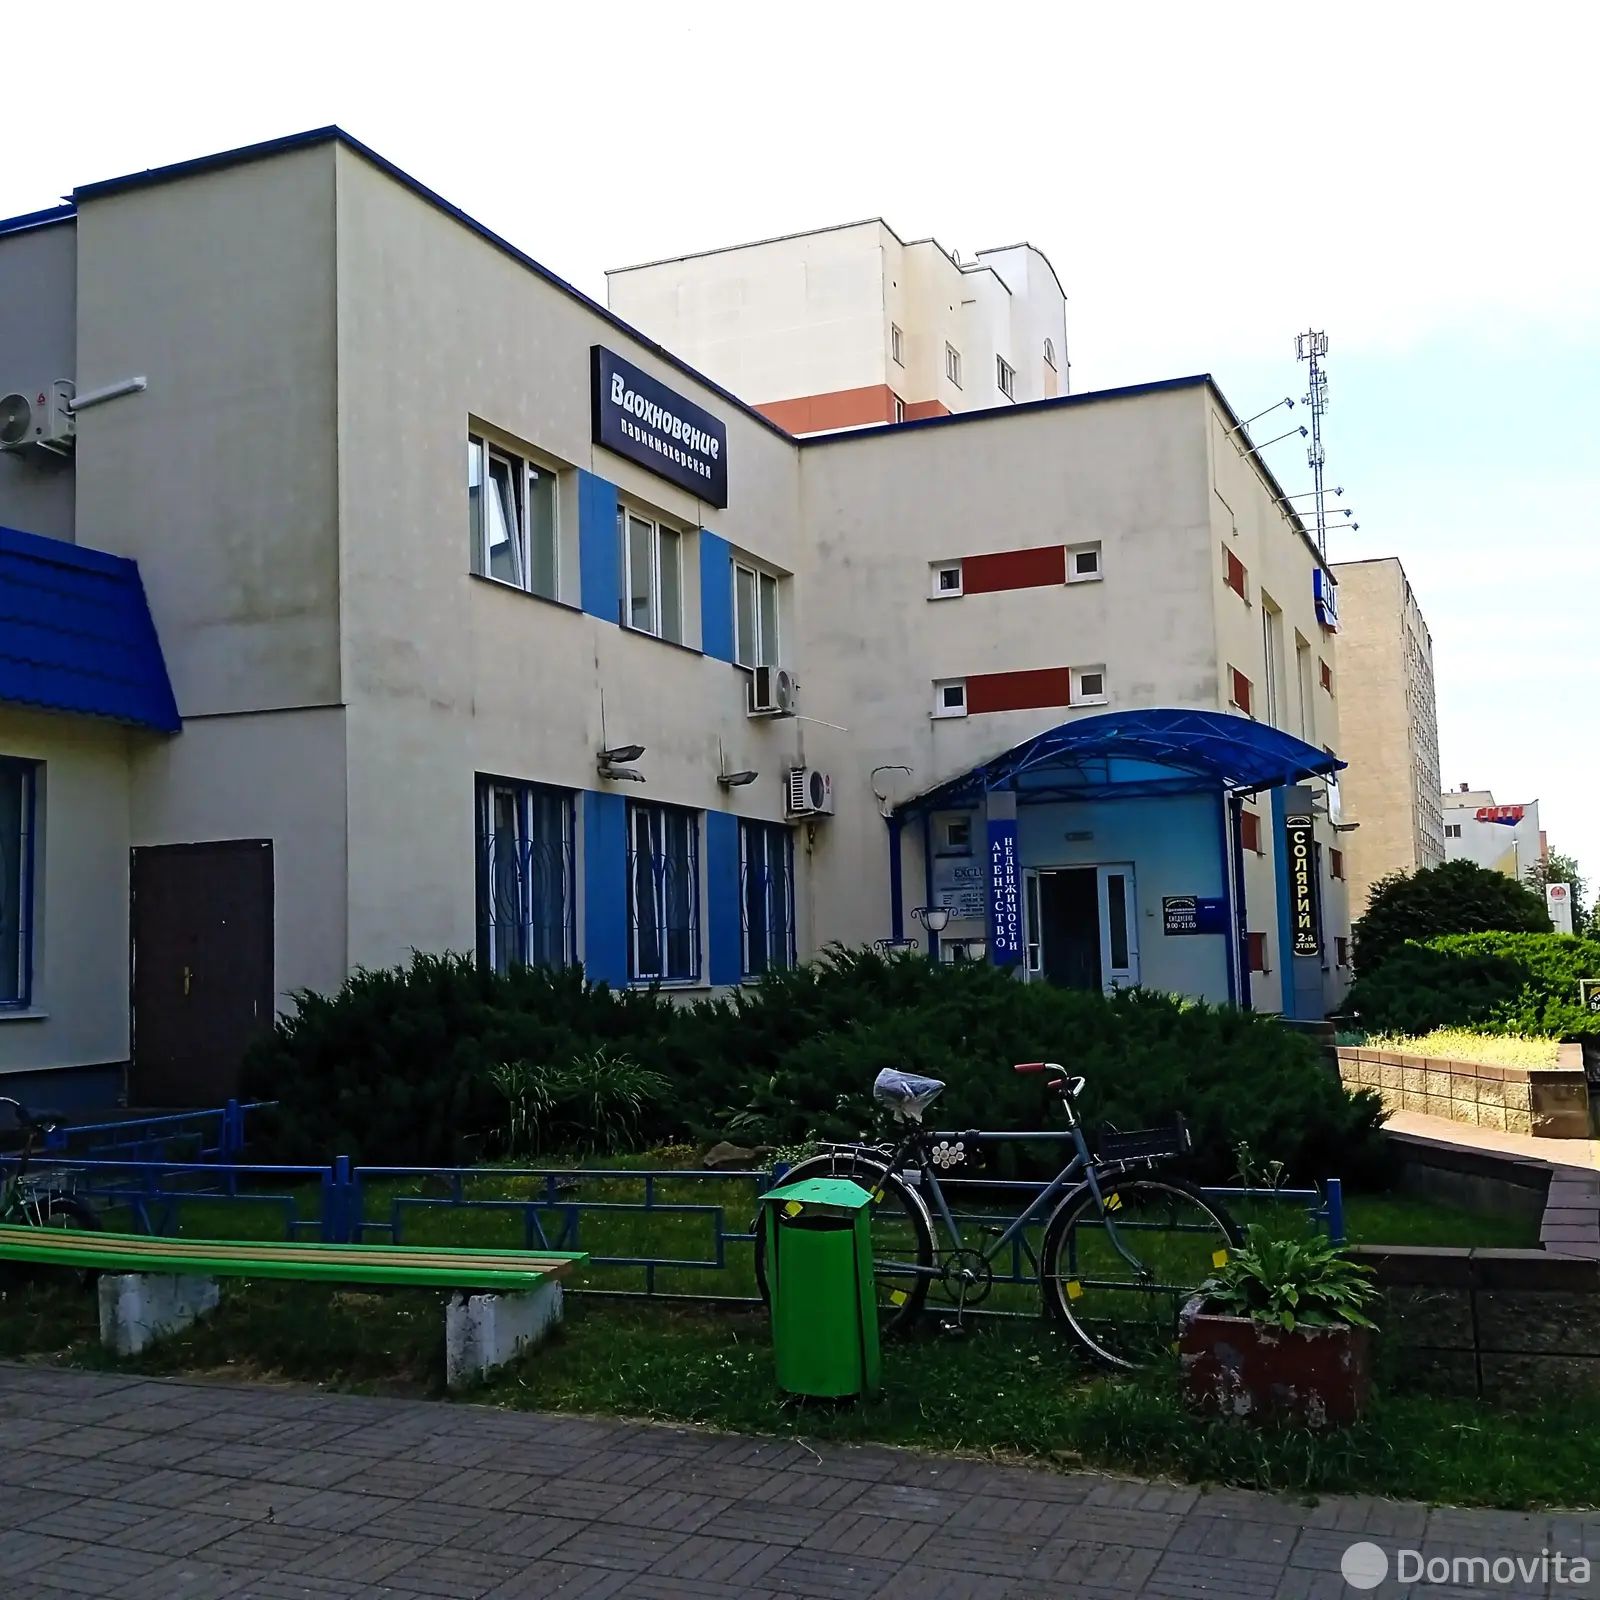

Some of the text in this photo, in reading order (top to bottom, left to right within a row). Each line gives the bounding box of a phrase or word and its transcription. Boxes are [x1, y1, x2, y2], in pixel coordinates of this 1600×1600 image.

[611, 372, 719, 460] Вдохновение
[621, 418, 711, 479] парикмахерская
[992, 841, 1006, 947] АГЕНТСТВО
[1004, 837, 1018, 951] НЕДВИЖИМОСТИ
[1293, 831, 1310, 928] СОЛЯРИЙ
[1297, 932, 1314, 942] 2-й
